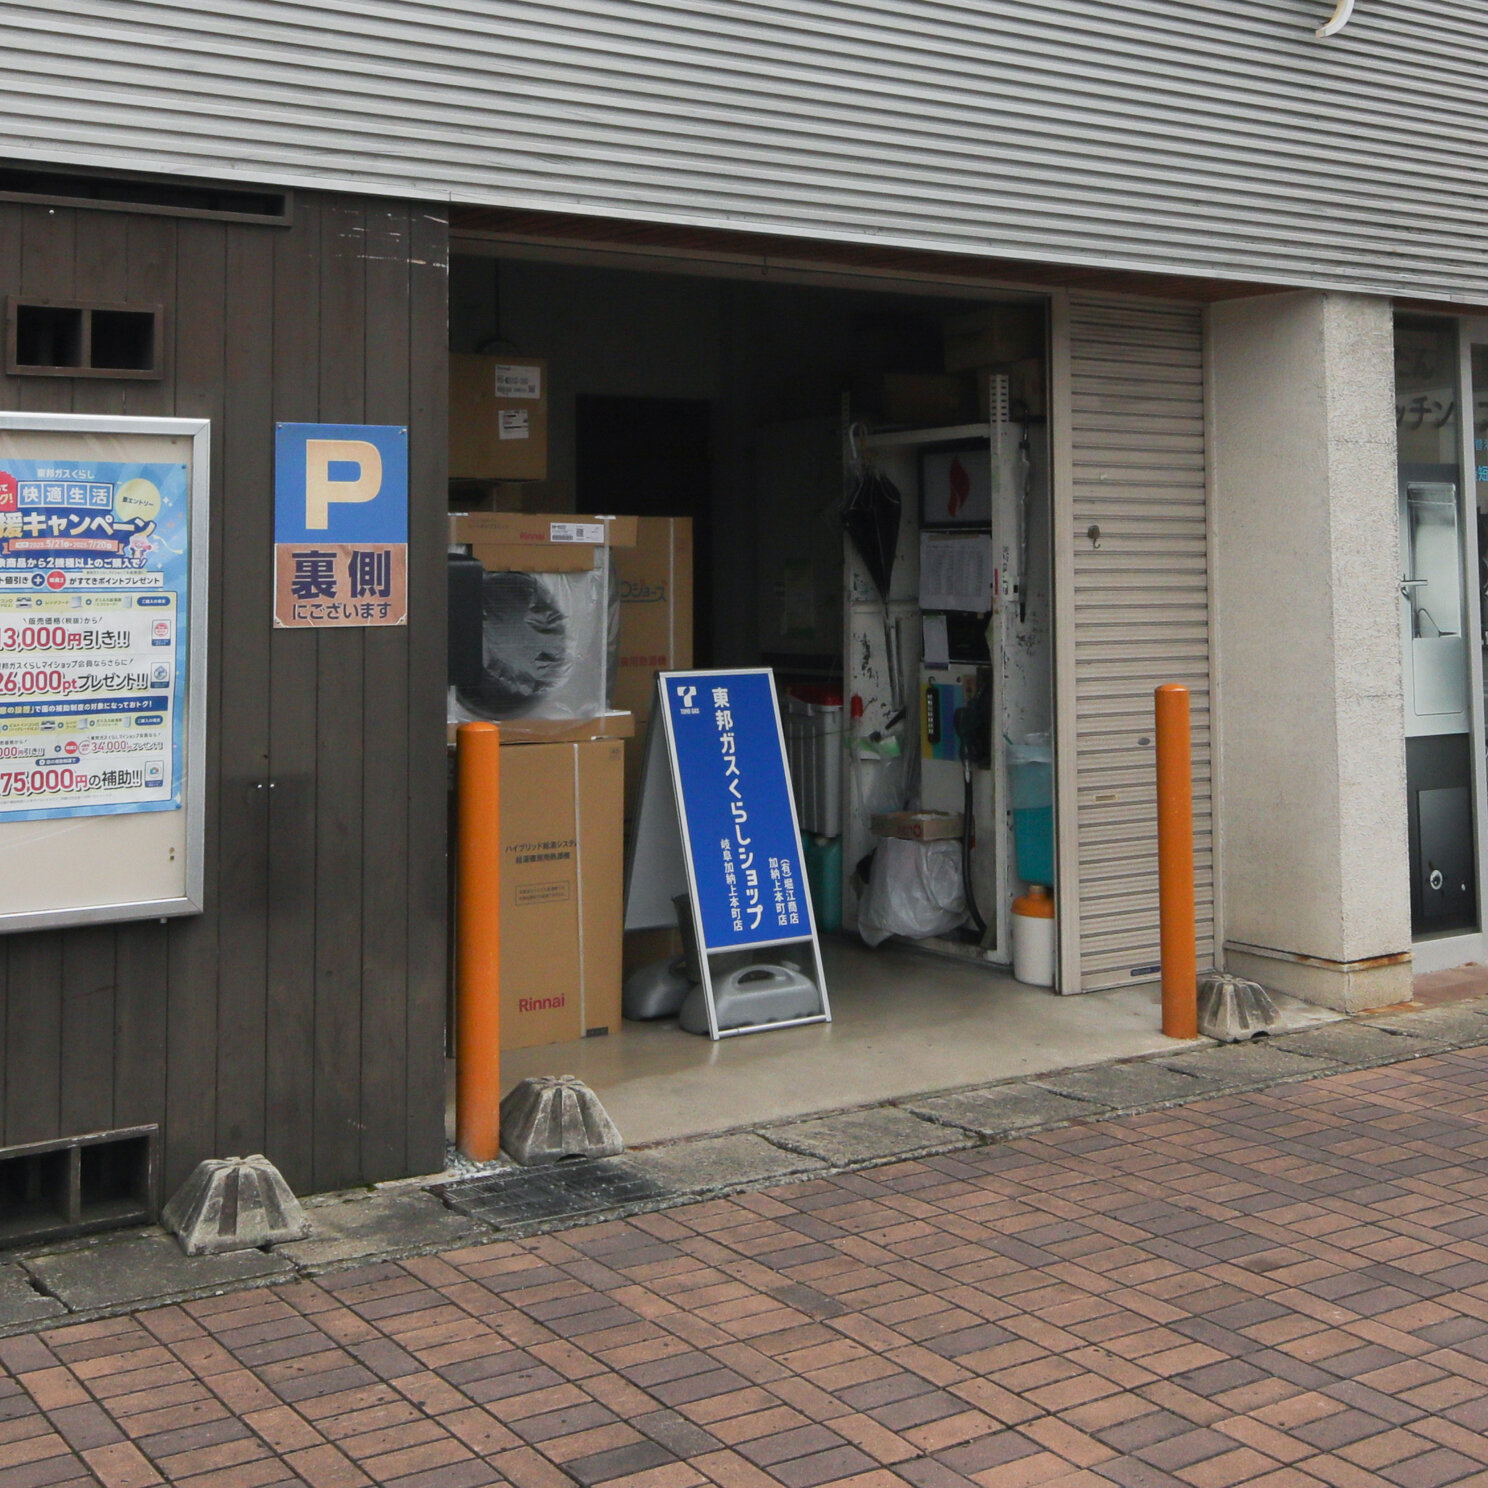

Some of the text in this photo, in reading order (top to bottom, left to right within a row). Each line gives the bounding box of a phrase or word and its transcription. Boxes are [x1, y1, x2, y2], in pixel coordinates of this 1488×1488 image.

[37, 469, 95, 480] 東邦ガスくらし
[305, 439, 383, 530] P
[22, 486, 108, 504] 快適生活
[69, 576, 160, 585] がすてきポイントプレゼント
[290, 550, 392, 600] 裏側
[292, 602, 392, 620] にございます
[712, 686, 763, 930] 東邦ガスくらしショップ
[720, 838, 744, 932] 岐阜加納上本町店
[768, 857, 788, 927] 加納上本町店
[518, 993, 565, 1013] Rinnai
